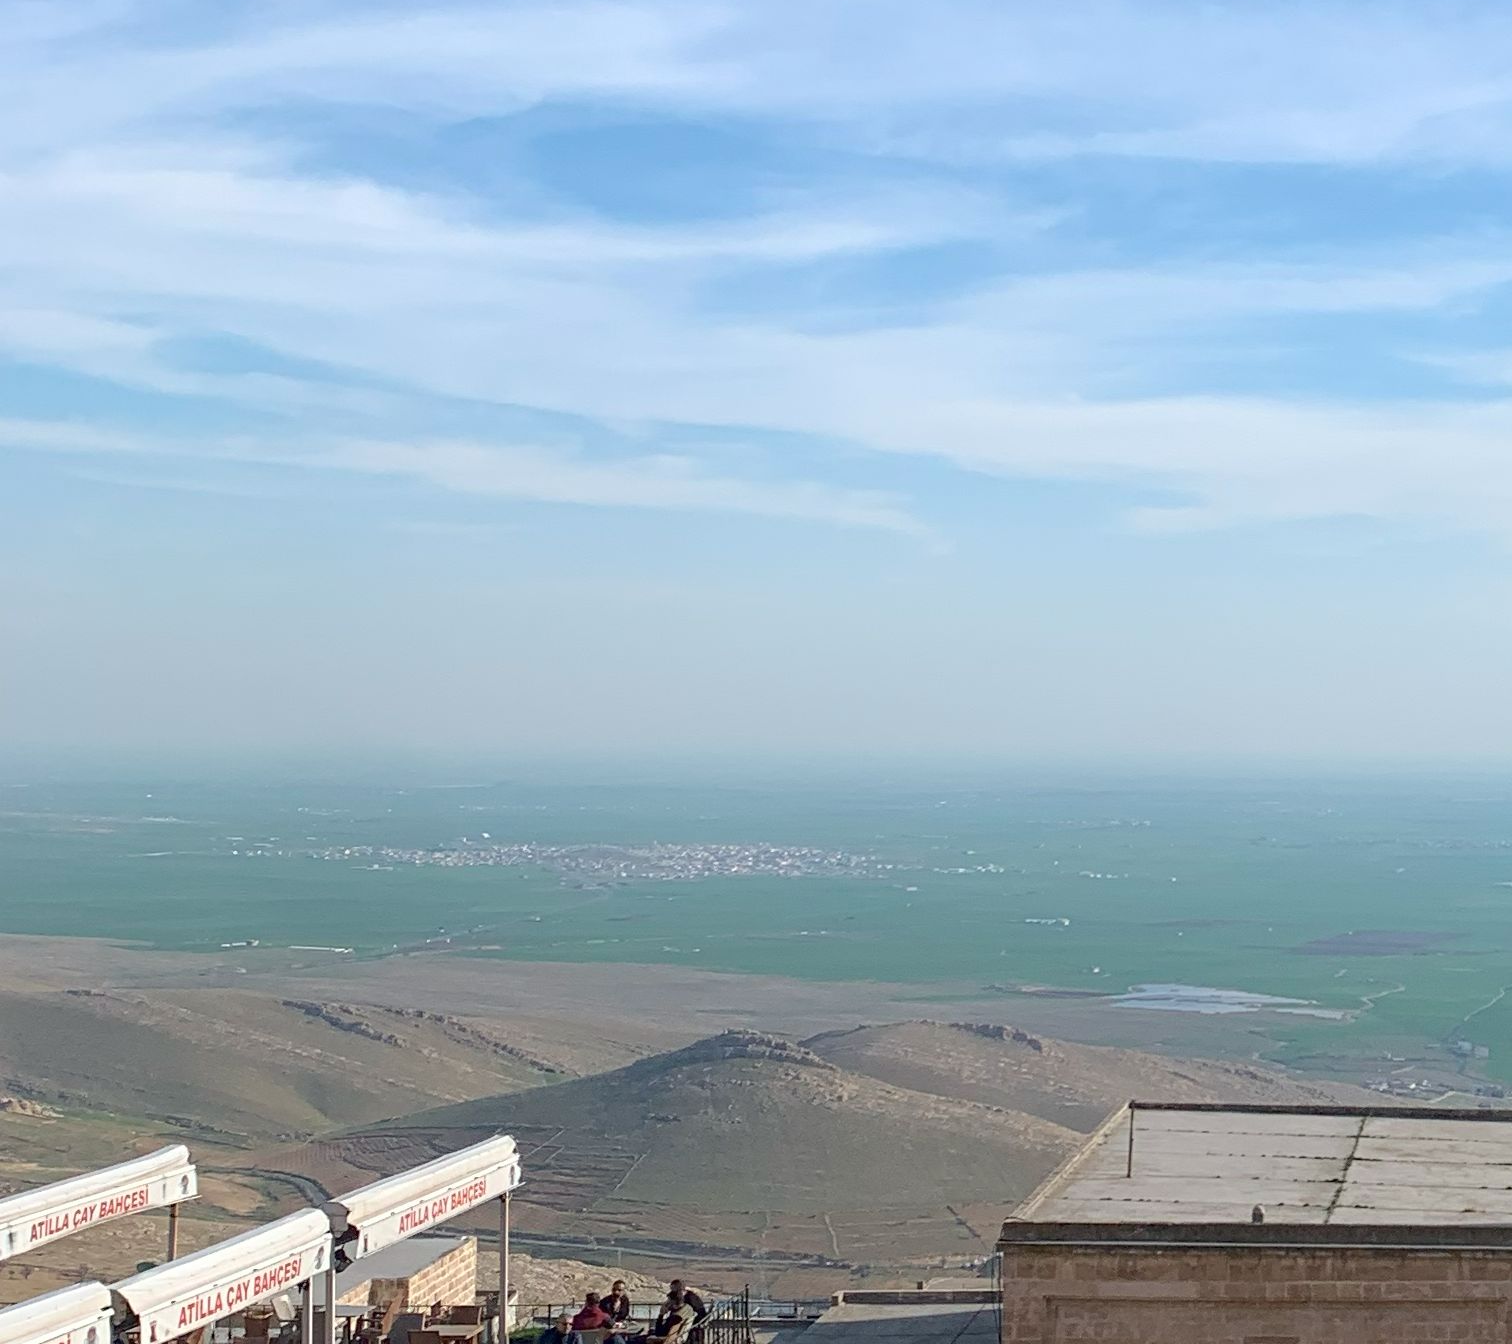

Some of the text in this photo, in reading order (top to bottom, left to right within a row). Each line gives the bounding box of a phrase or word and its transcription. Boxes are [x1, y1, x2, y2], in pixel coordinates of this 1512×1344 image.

[30, 1184, 149, 1242] ATİLLA ÇAY BAHÇESİ
[399, 1177, 486, 1234] ATİLLA ÇAY BAHÇESİ
[178, 1253, 302, 1328] ATİLLA ÇAY BAHÇESİ
